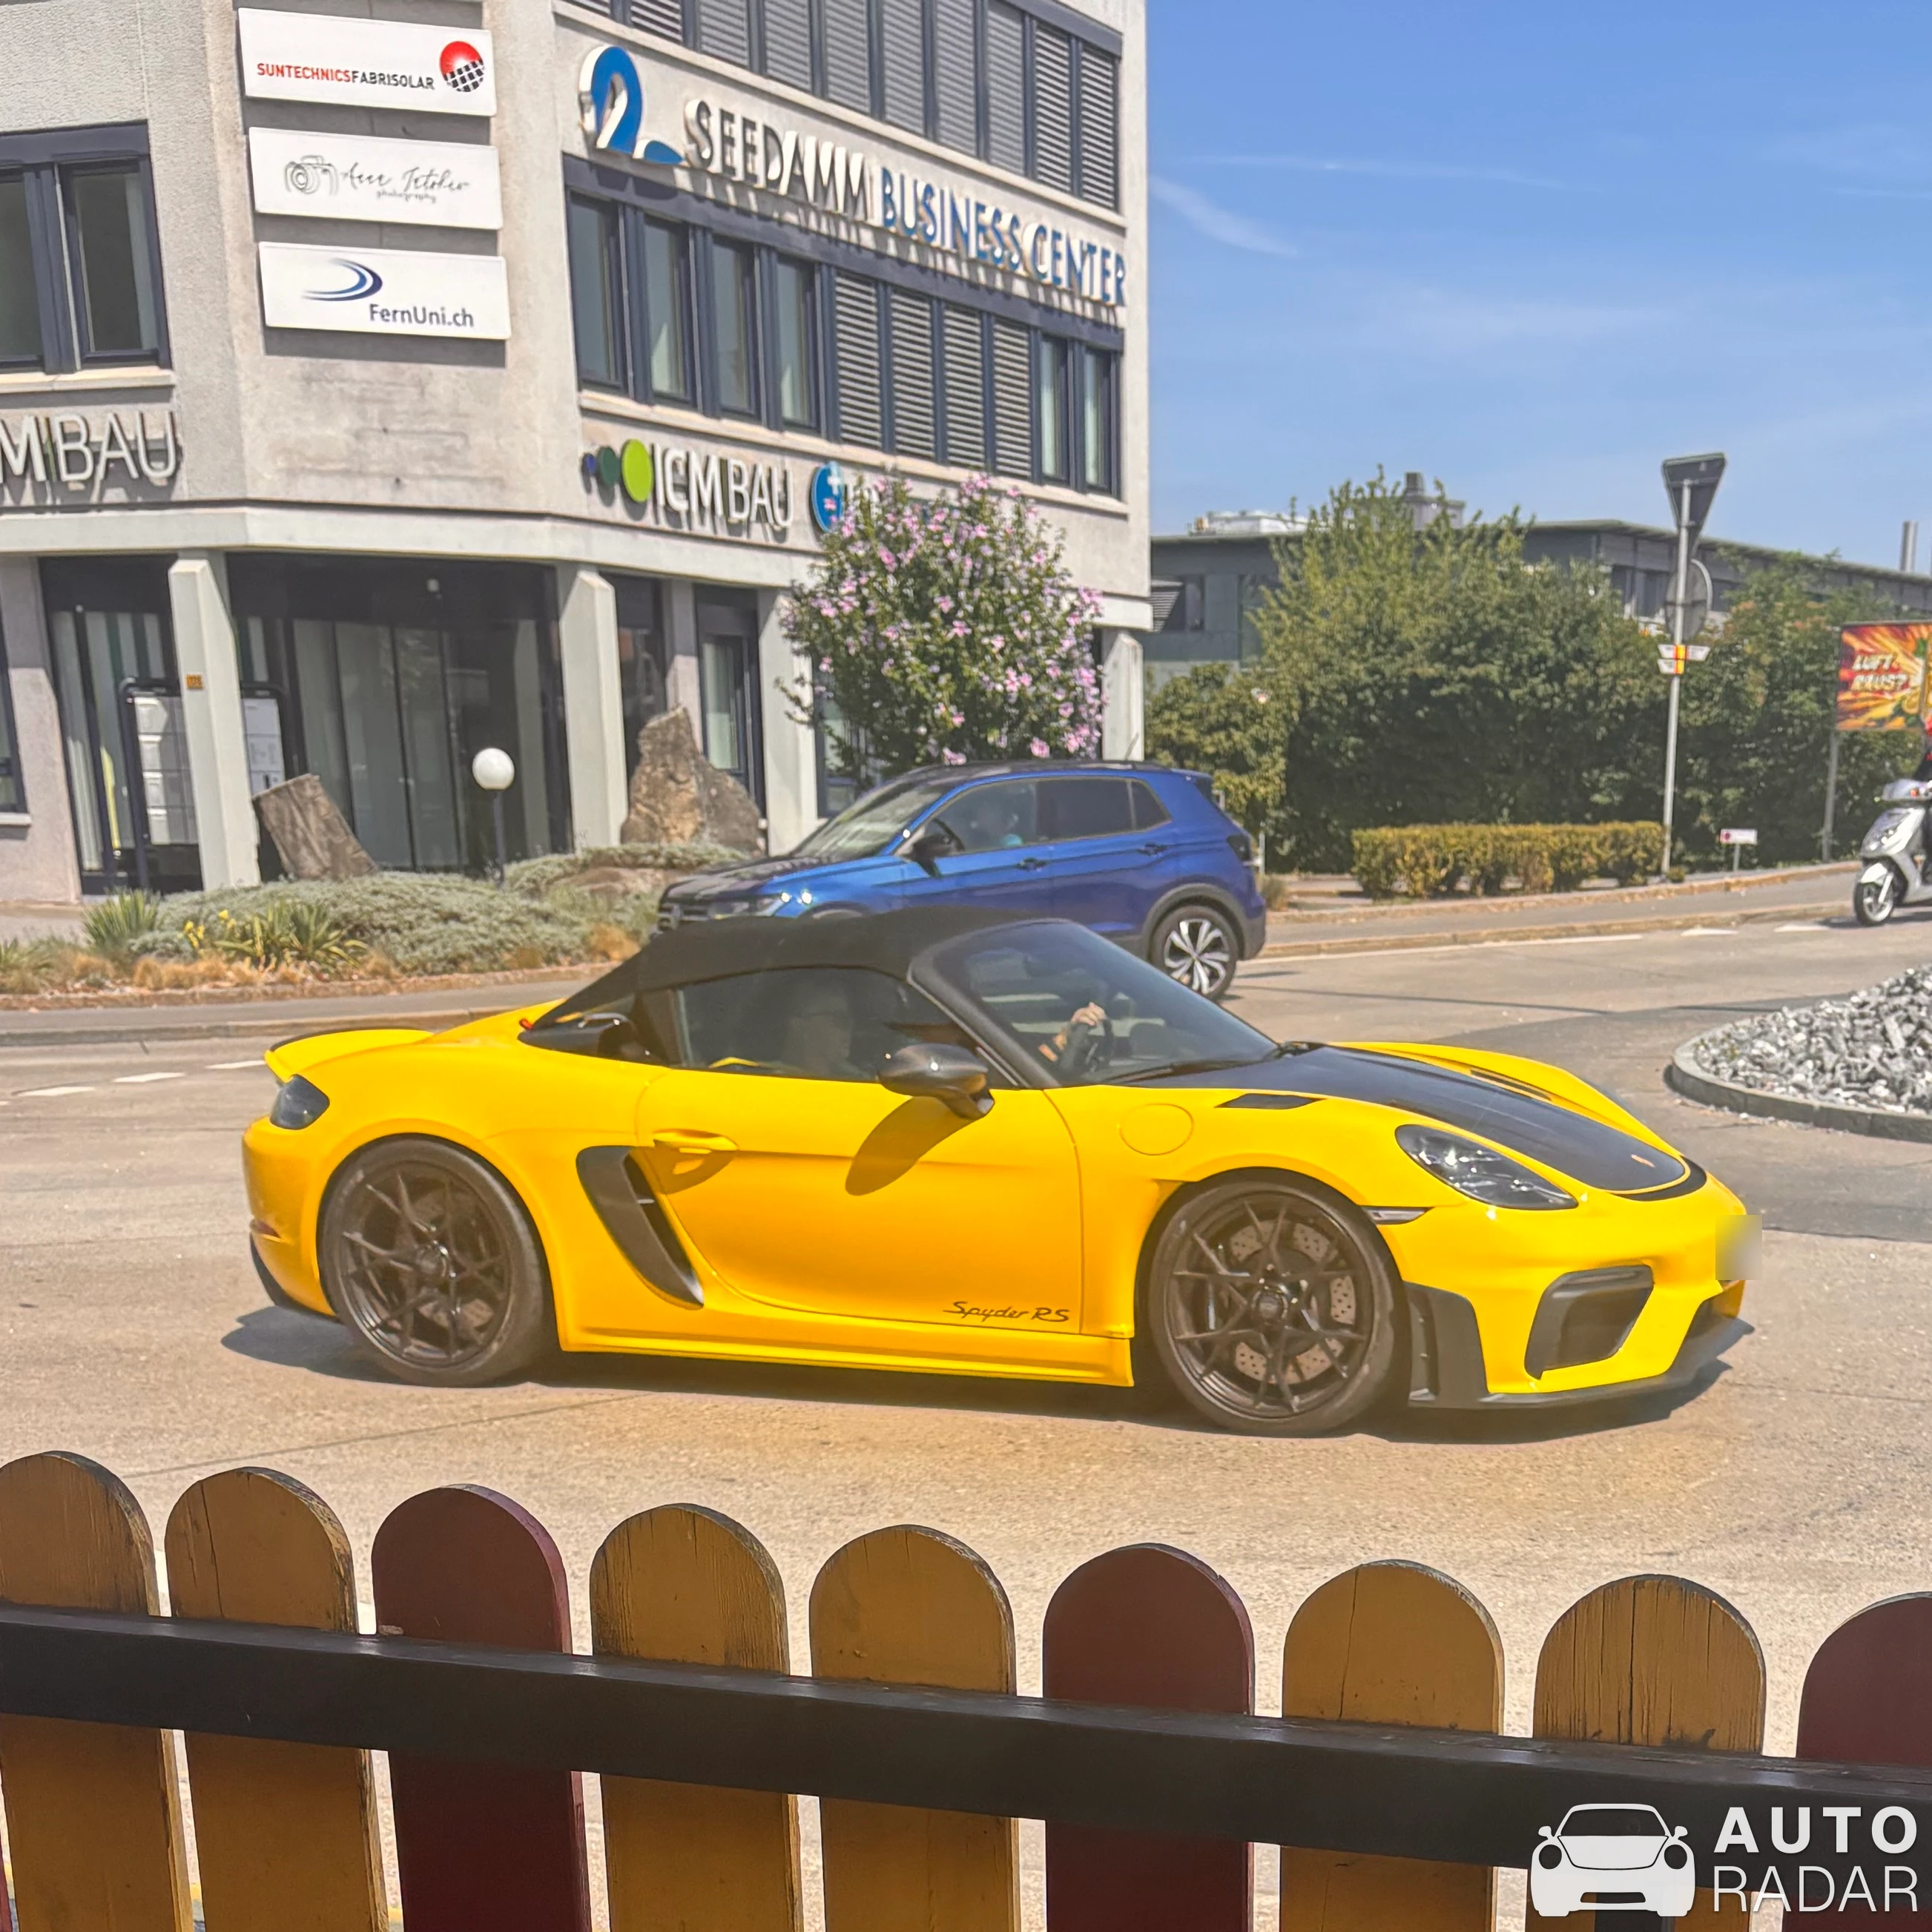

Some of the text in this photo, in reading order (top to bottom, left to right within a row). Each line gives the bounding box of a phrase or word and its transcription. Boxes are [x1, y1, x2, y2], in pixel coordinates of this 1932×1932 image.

[257, 62, 435, 90] SUNTECHNICSFABRISOLAR
[684, 98, 1127, 307] SEEDAMM BUSINESS CENTER
[369, 303, 474, 329] FernUni.ch
[943, 1301, 1070, 1322] Spyder RS
